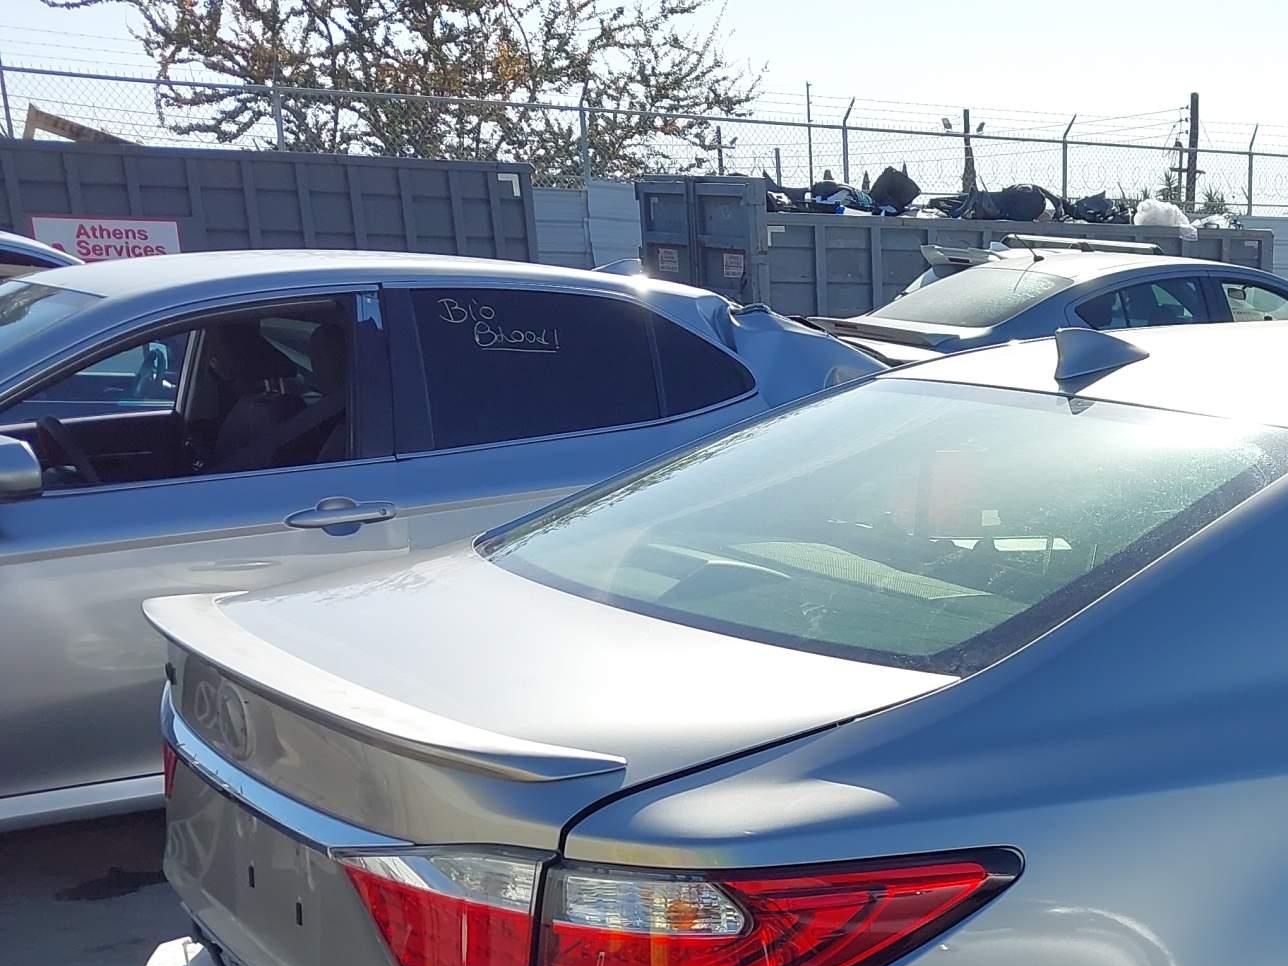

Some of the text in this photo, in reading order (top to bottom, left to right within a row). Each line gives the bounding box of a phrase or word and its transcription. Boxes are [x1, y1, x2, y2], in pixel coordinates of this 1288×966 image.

[76, 223, 149, 240] Athens
[76, 240, 167, 257] Services
[438, 298, 495, 323] Bio
